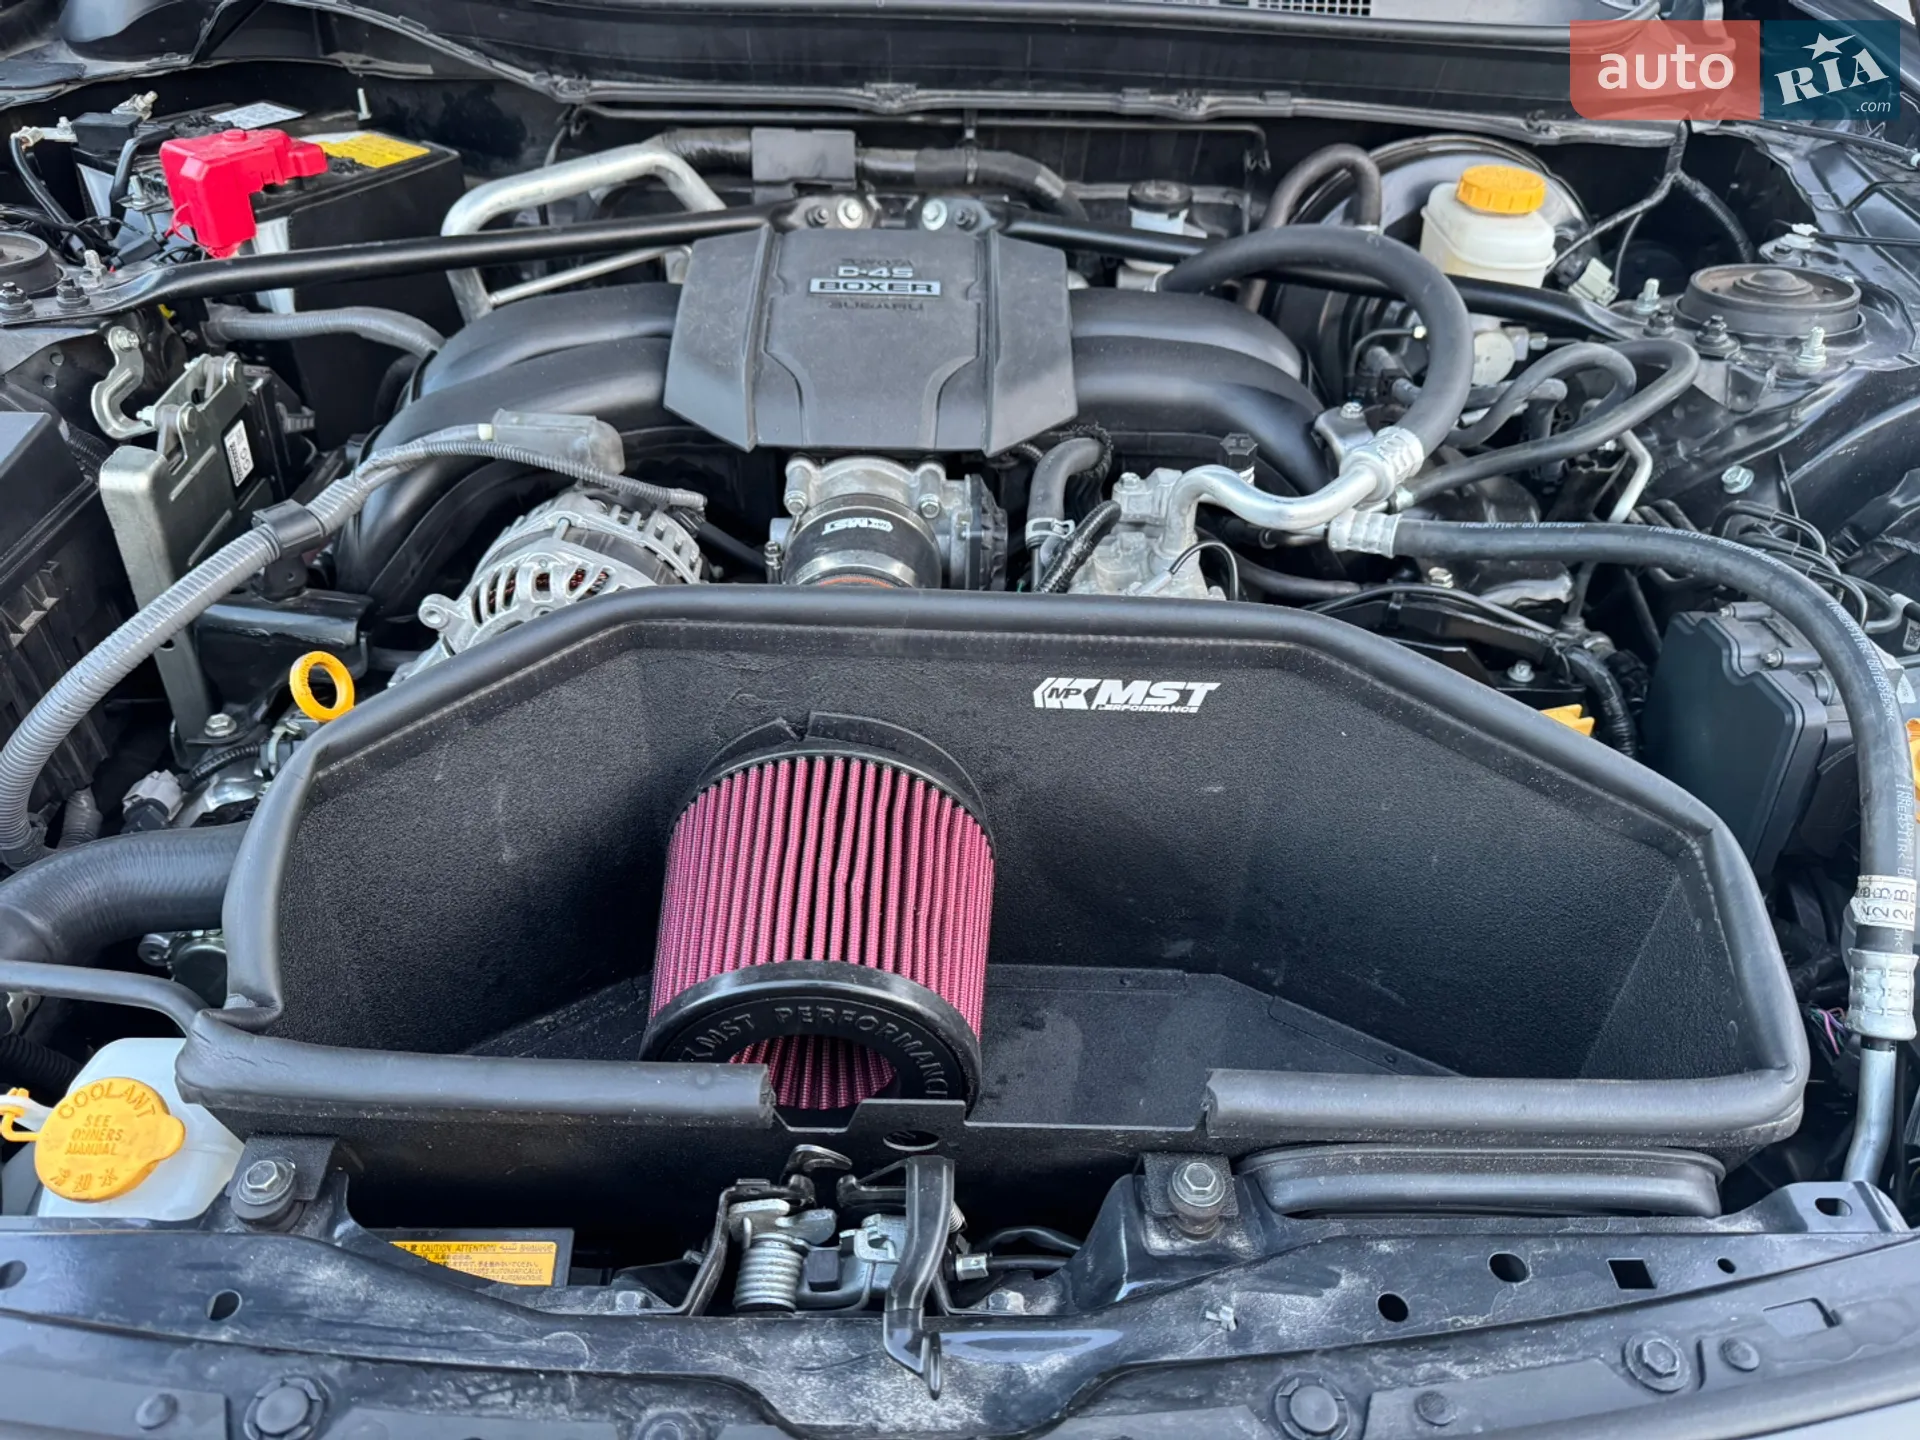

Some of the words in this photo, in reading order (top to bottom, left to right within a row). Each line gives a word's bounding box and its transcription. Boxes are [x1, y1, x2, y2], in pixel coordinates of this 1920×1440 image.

[819, 281, 933, 293] BOXER
[828, 301, 924, 311] SUBARU
[1092, 679, 1222, 708] MST
[1097, 704, 1200, 713] PERFORMANCE
[697, 1013, 755, 1057] MST
[58, 1082, 156, 1119] COOLANT
[84, 1114, 112, 1128] SEE
[65, 1143, 119, 1156] MANUAL
[421, 1244, 450, 1252] CAUTION
[456, 1244, 496, 1252] ATTENTION
